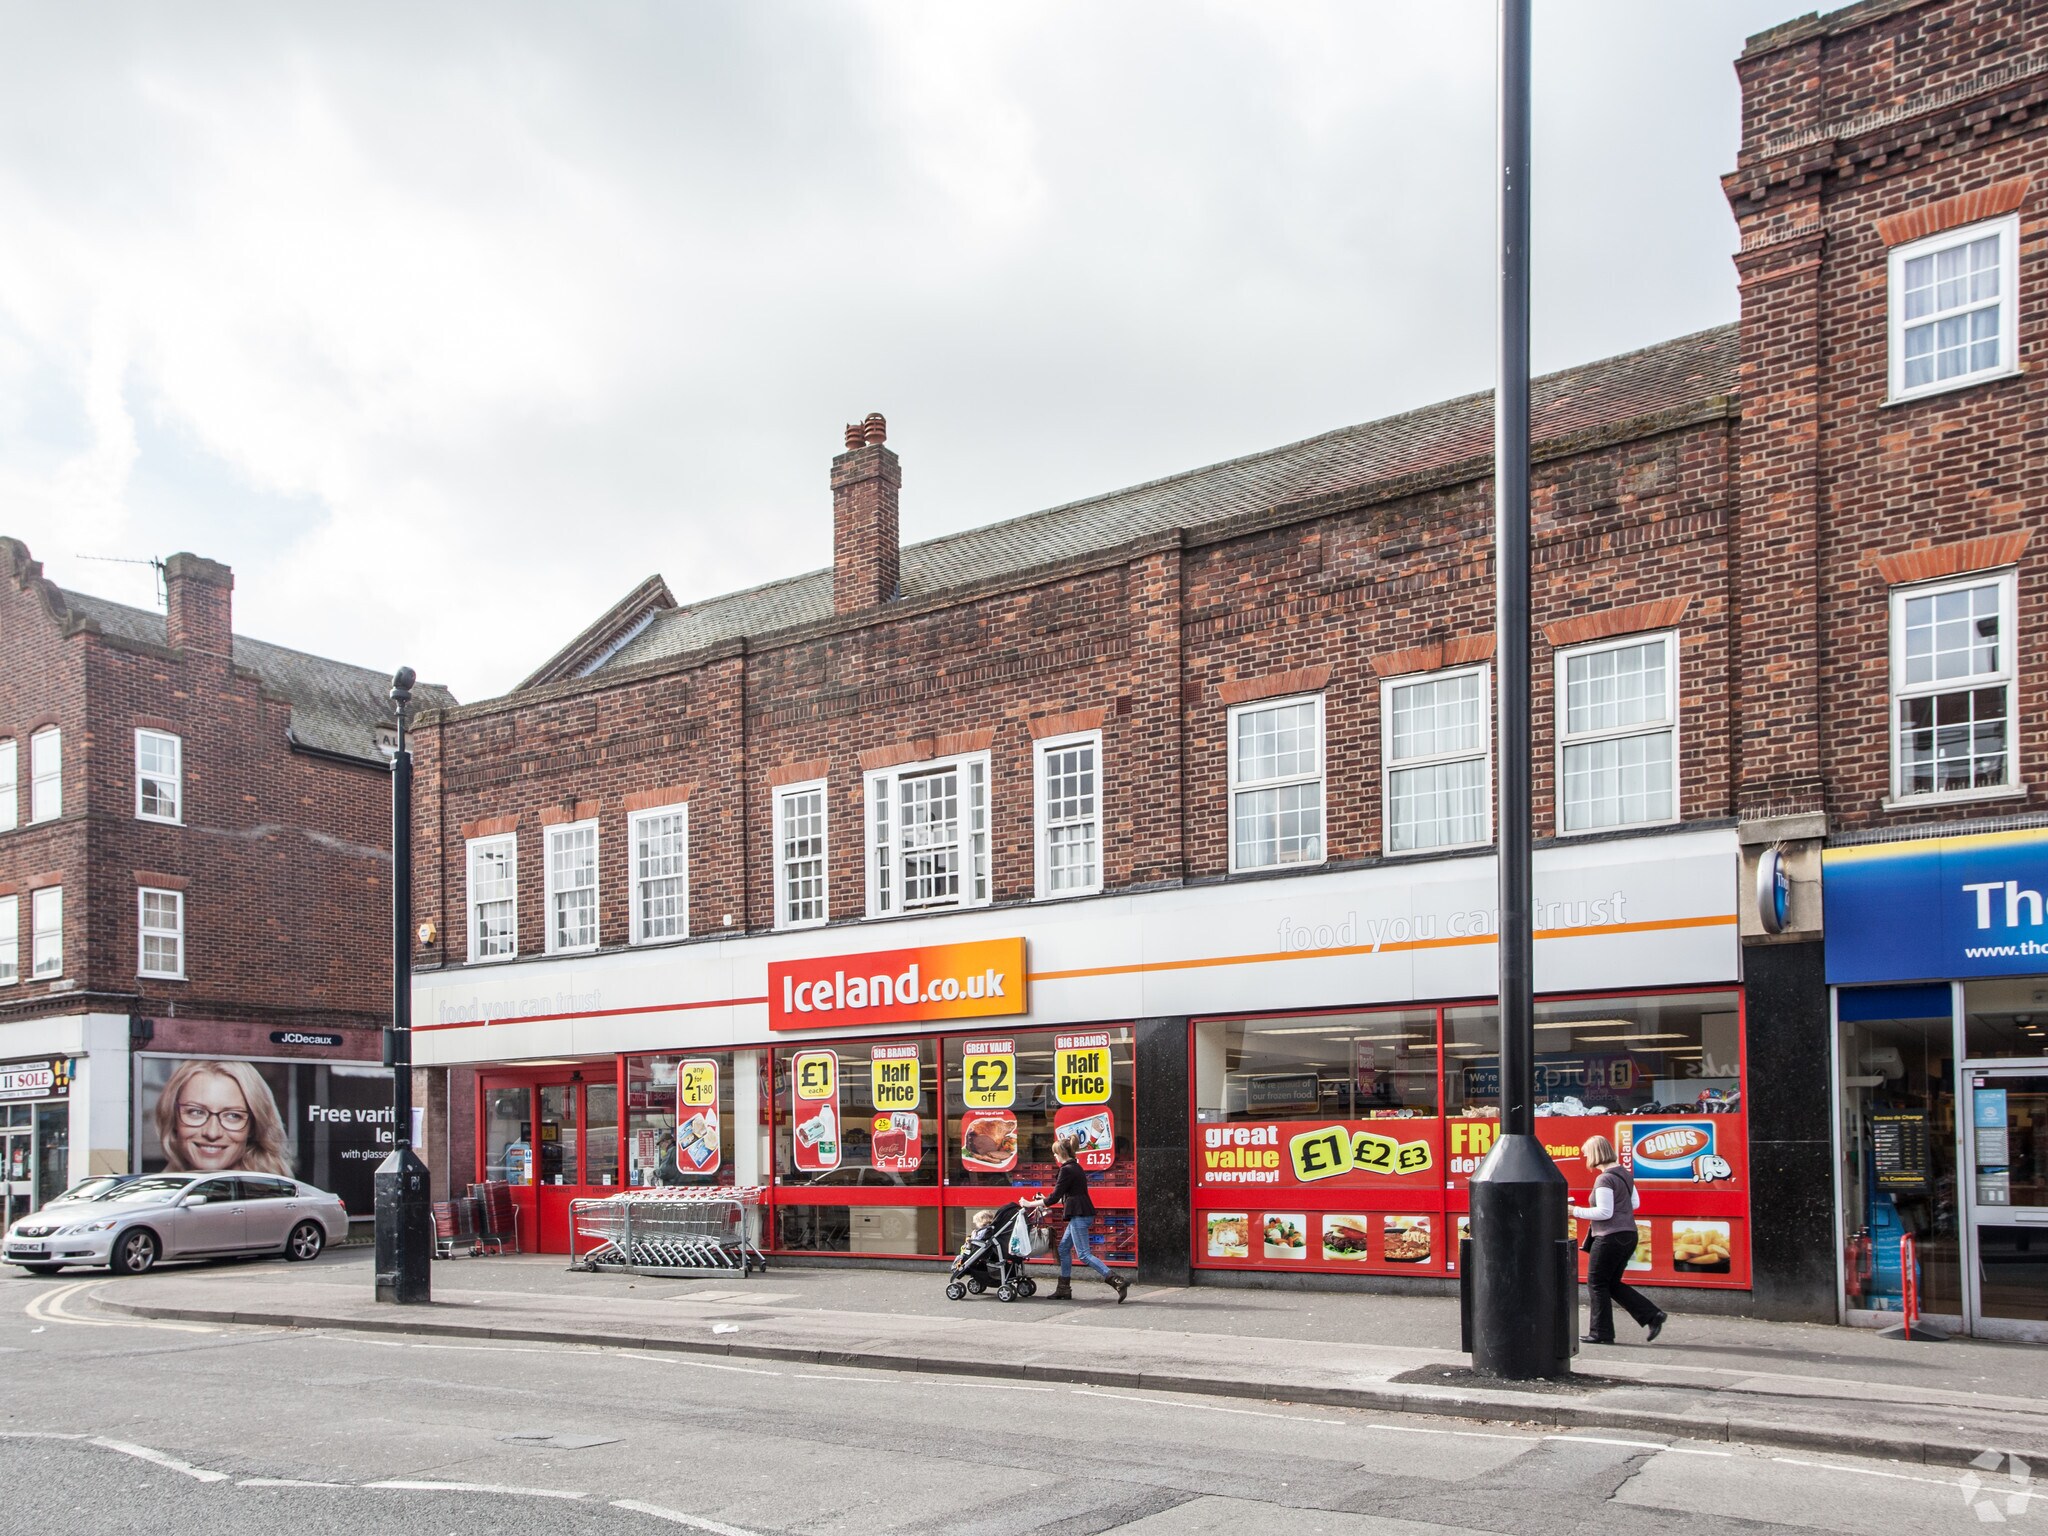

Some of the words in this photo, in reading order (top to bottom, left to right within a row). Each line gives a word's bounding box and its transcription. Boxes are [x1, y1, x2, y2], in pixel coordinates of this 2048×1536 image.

[1962, 880, 2048, 929] Th
[1278, 911, 1357, 953] food
[1367, 914, 1436, 953] you
[1446, 907, 1498, 938] ca
[1533, 890, 1628, 931] trust
[783, 963, 1005, 1014] Iceland.co.uk
[439, 998, 478, 1023] food
[482, 999, 516, 1027] you
[519, 997, 552, 1017] can
[556, 988, 602, 1013] trust
[281, 1033, 332, 1045] JCDecaux
[966, 1043, 989, 1053] GREAT
[989, 1042, 1012, 1052] VALUE
[1057, 1038, 1072, 1047] BIG
[1073, 1035, 1108, 1046] BRANDS
[874, 1048, 887, 1058] BIG
[887, 1047, 917, 1057] BRANDS
[881, 1063, 910, 1082] Half
[1066, 1053, 1099, 1074] Half
[18, 1071, 49, 1087] SOLE
[685, 1073, 694, 1091] 2
[801, 1061, 829, 1087] £1
[969, 1060, 1009, 1092] £2
[1470, 1073, 1497, 1082] We're
[877, 1084, 914, 1102] Price
[1061, 1075, 1105, 1095] Price
[1252, 1081, 1276, 1089] We're
[1302, 1079, 1311, 1088] of
[981, 1093, 996, 1102] off
[1267, 1091, 1292, 1099] frozen
[1293, 1090, 1314, 1099] food.
[308, 1105, 351, 1122] Free
[375, 1127, 395, 1143] le
[1204, 1125, 1278, 1148] great
[1451, 1123, 1500, 1154] FR
[1644, 1130, 1698, 1154] BONUS
[341, 1149, 360, 1159] with
[1086, 1153, 1111, 1165] £1.25
[1204, 1147, 1280, 1168] value
[1302, 1134, 1342, 1173] £1
[1354, 1139, 1391, 1167] £2
[1398, 1147, 1428, 1169] £3
[1545, 1144, 1580, 1158] Swipe
[1663, 1147, 1684, 1157] CARD
[897, 1157, 918, 1168] £1.50
[1204, 1170, 1280, 1183] everyday!
